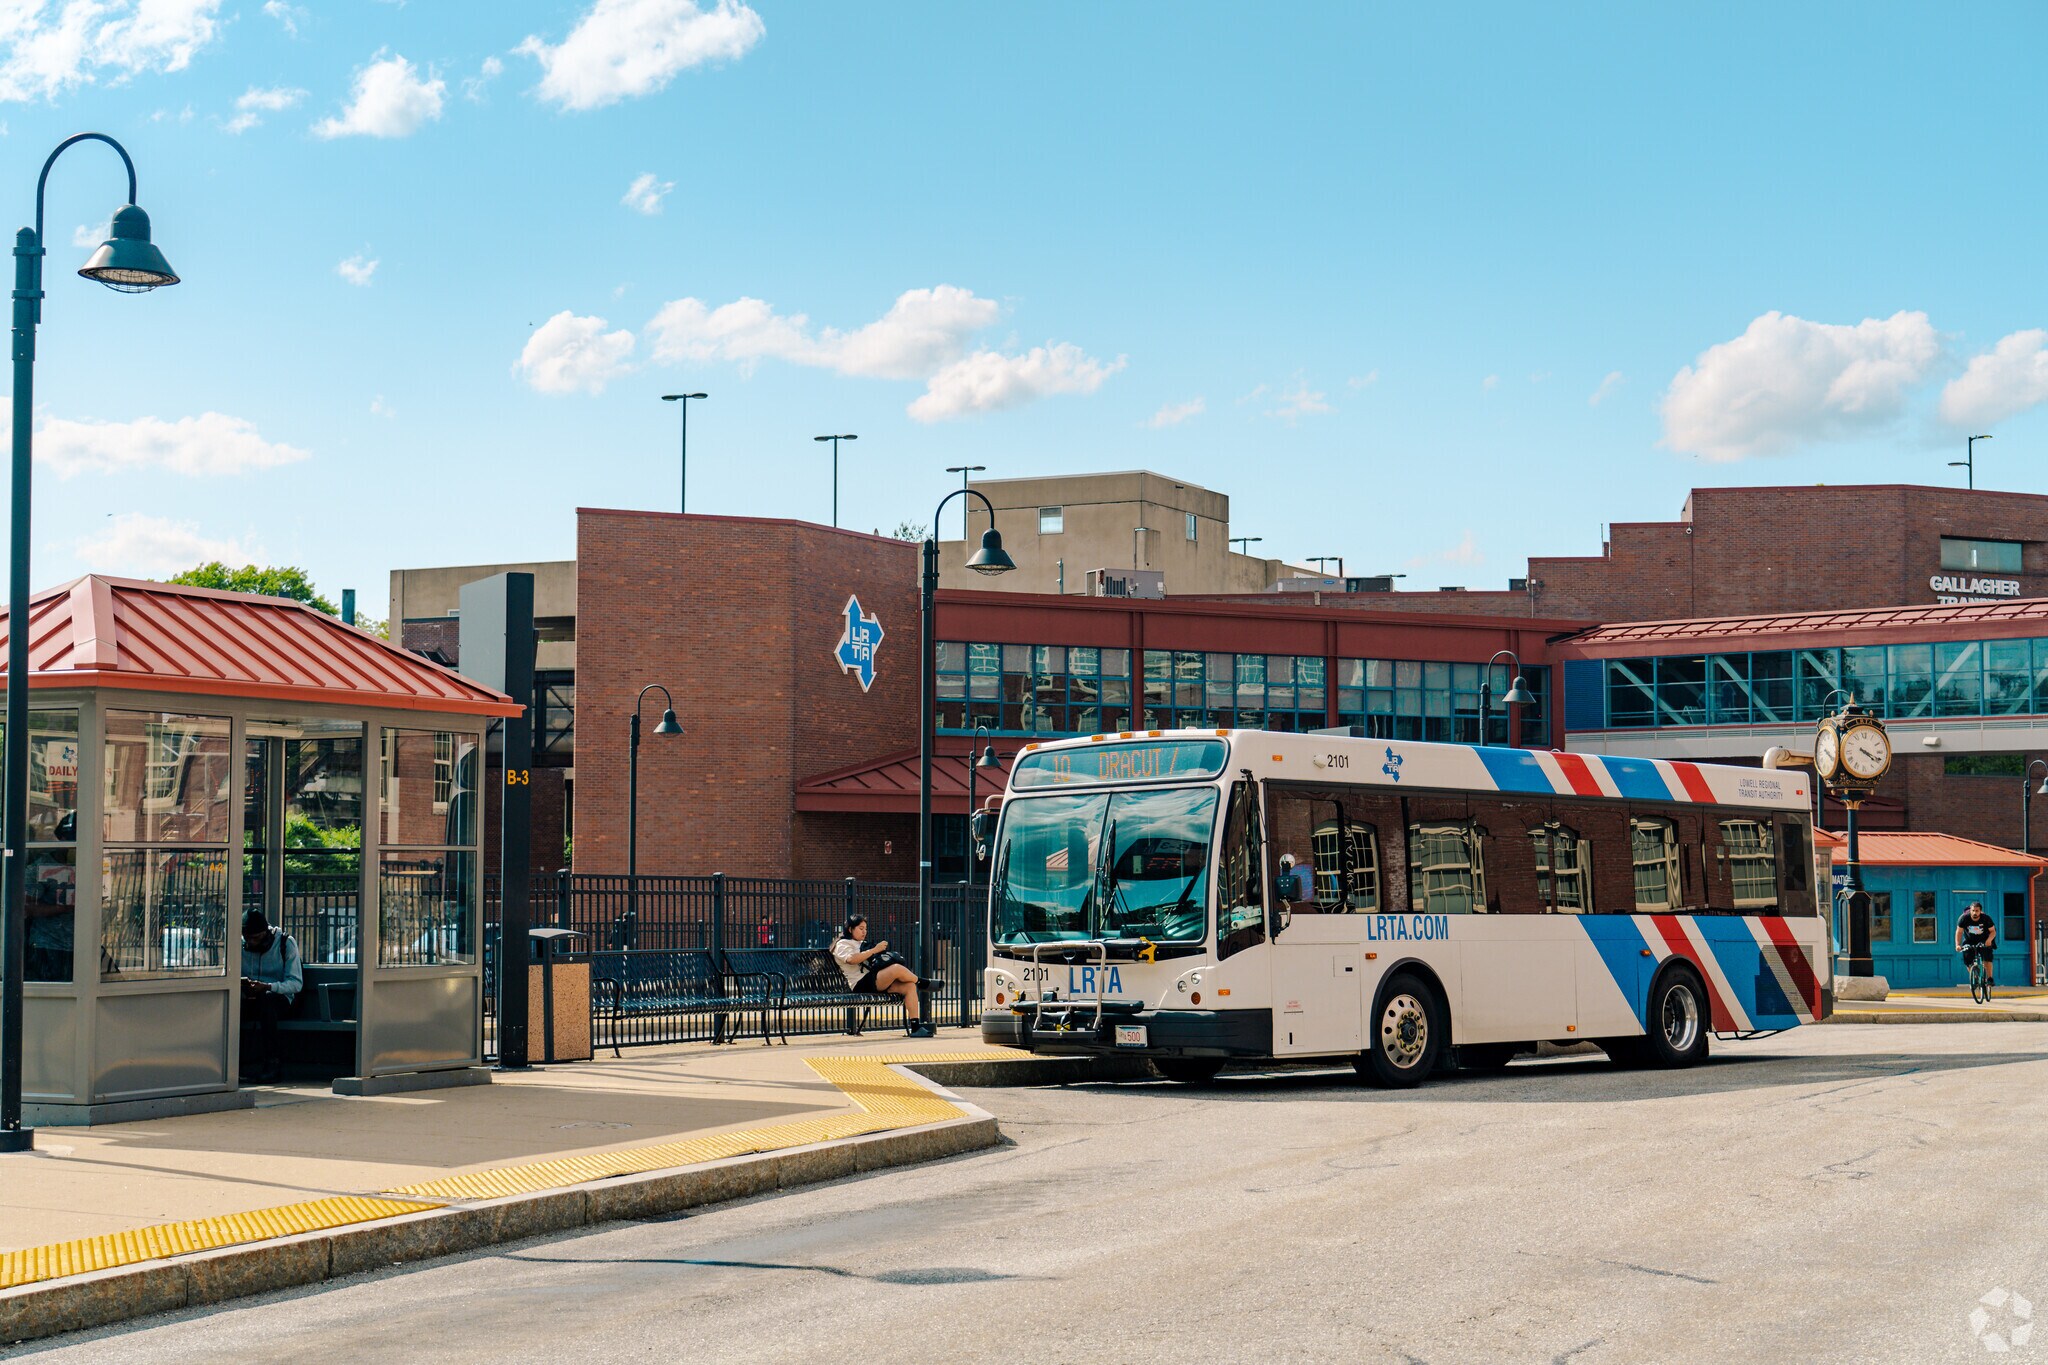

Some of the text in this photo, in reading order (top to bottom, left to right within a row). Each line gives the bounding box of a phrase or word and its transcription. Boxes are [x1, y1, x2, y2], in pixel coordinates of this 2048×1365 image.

[1929, 575, 2020, 596] GALLAGHER
[1053, 754, 1071, 782] 10
[1099, 748, 1161, 780] DRACUT
[1327, 754, 1349, 768] 2101
[49, 765, 78, 776] DAILY
[507, 769, 529, 785] B-3
[1739, 778, 1781, 789] LOWELL REGIONAL
[1739, 789, 1783, 800] TRANSIT AUTHORITY
[1367, 915, 1449, 941] LRTA.COM
[1023, 967, 1049, 981] 2101
[1069, 966, 1122, 994] LRTA
[1127, 1031, 1141, 1042] 500
